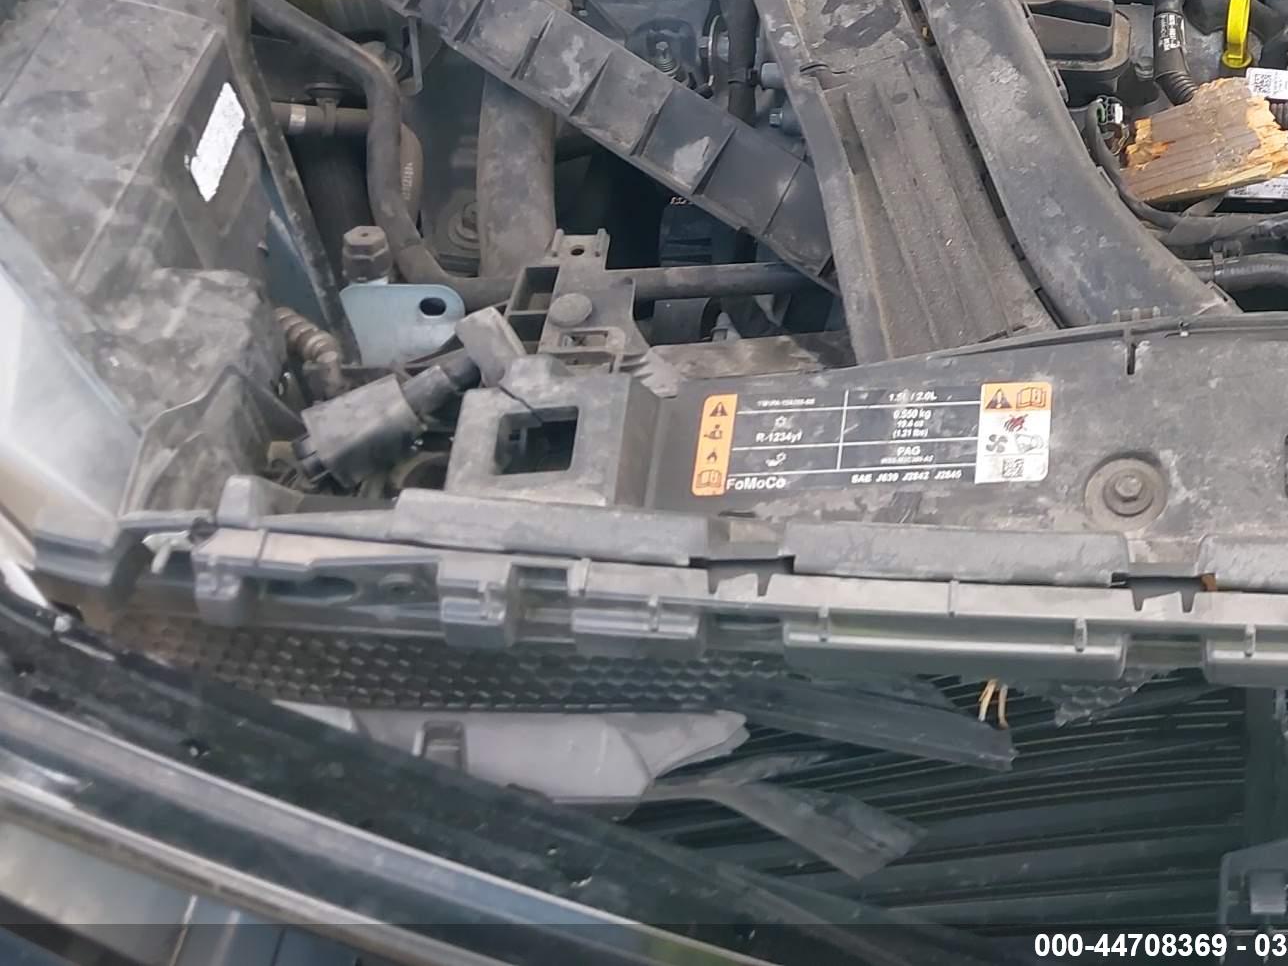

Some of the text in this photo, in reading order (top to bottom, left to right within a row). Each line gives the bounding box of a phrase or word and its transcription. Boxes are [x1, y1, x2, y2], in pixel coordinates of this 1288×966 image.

[916, 390, 938, 401] 2.0L
[918, 408, 932, 420] kg
[897, 445, 921, 456] PAG
[726, 476, 787, 490] FoMoCo
[851, 474, 873, 484] SAE
